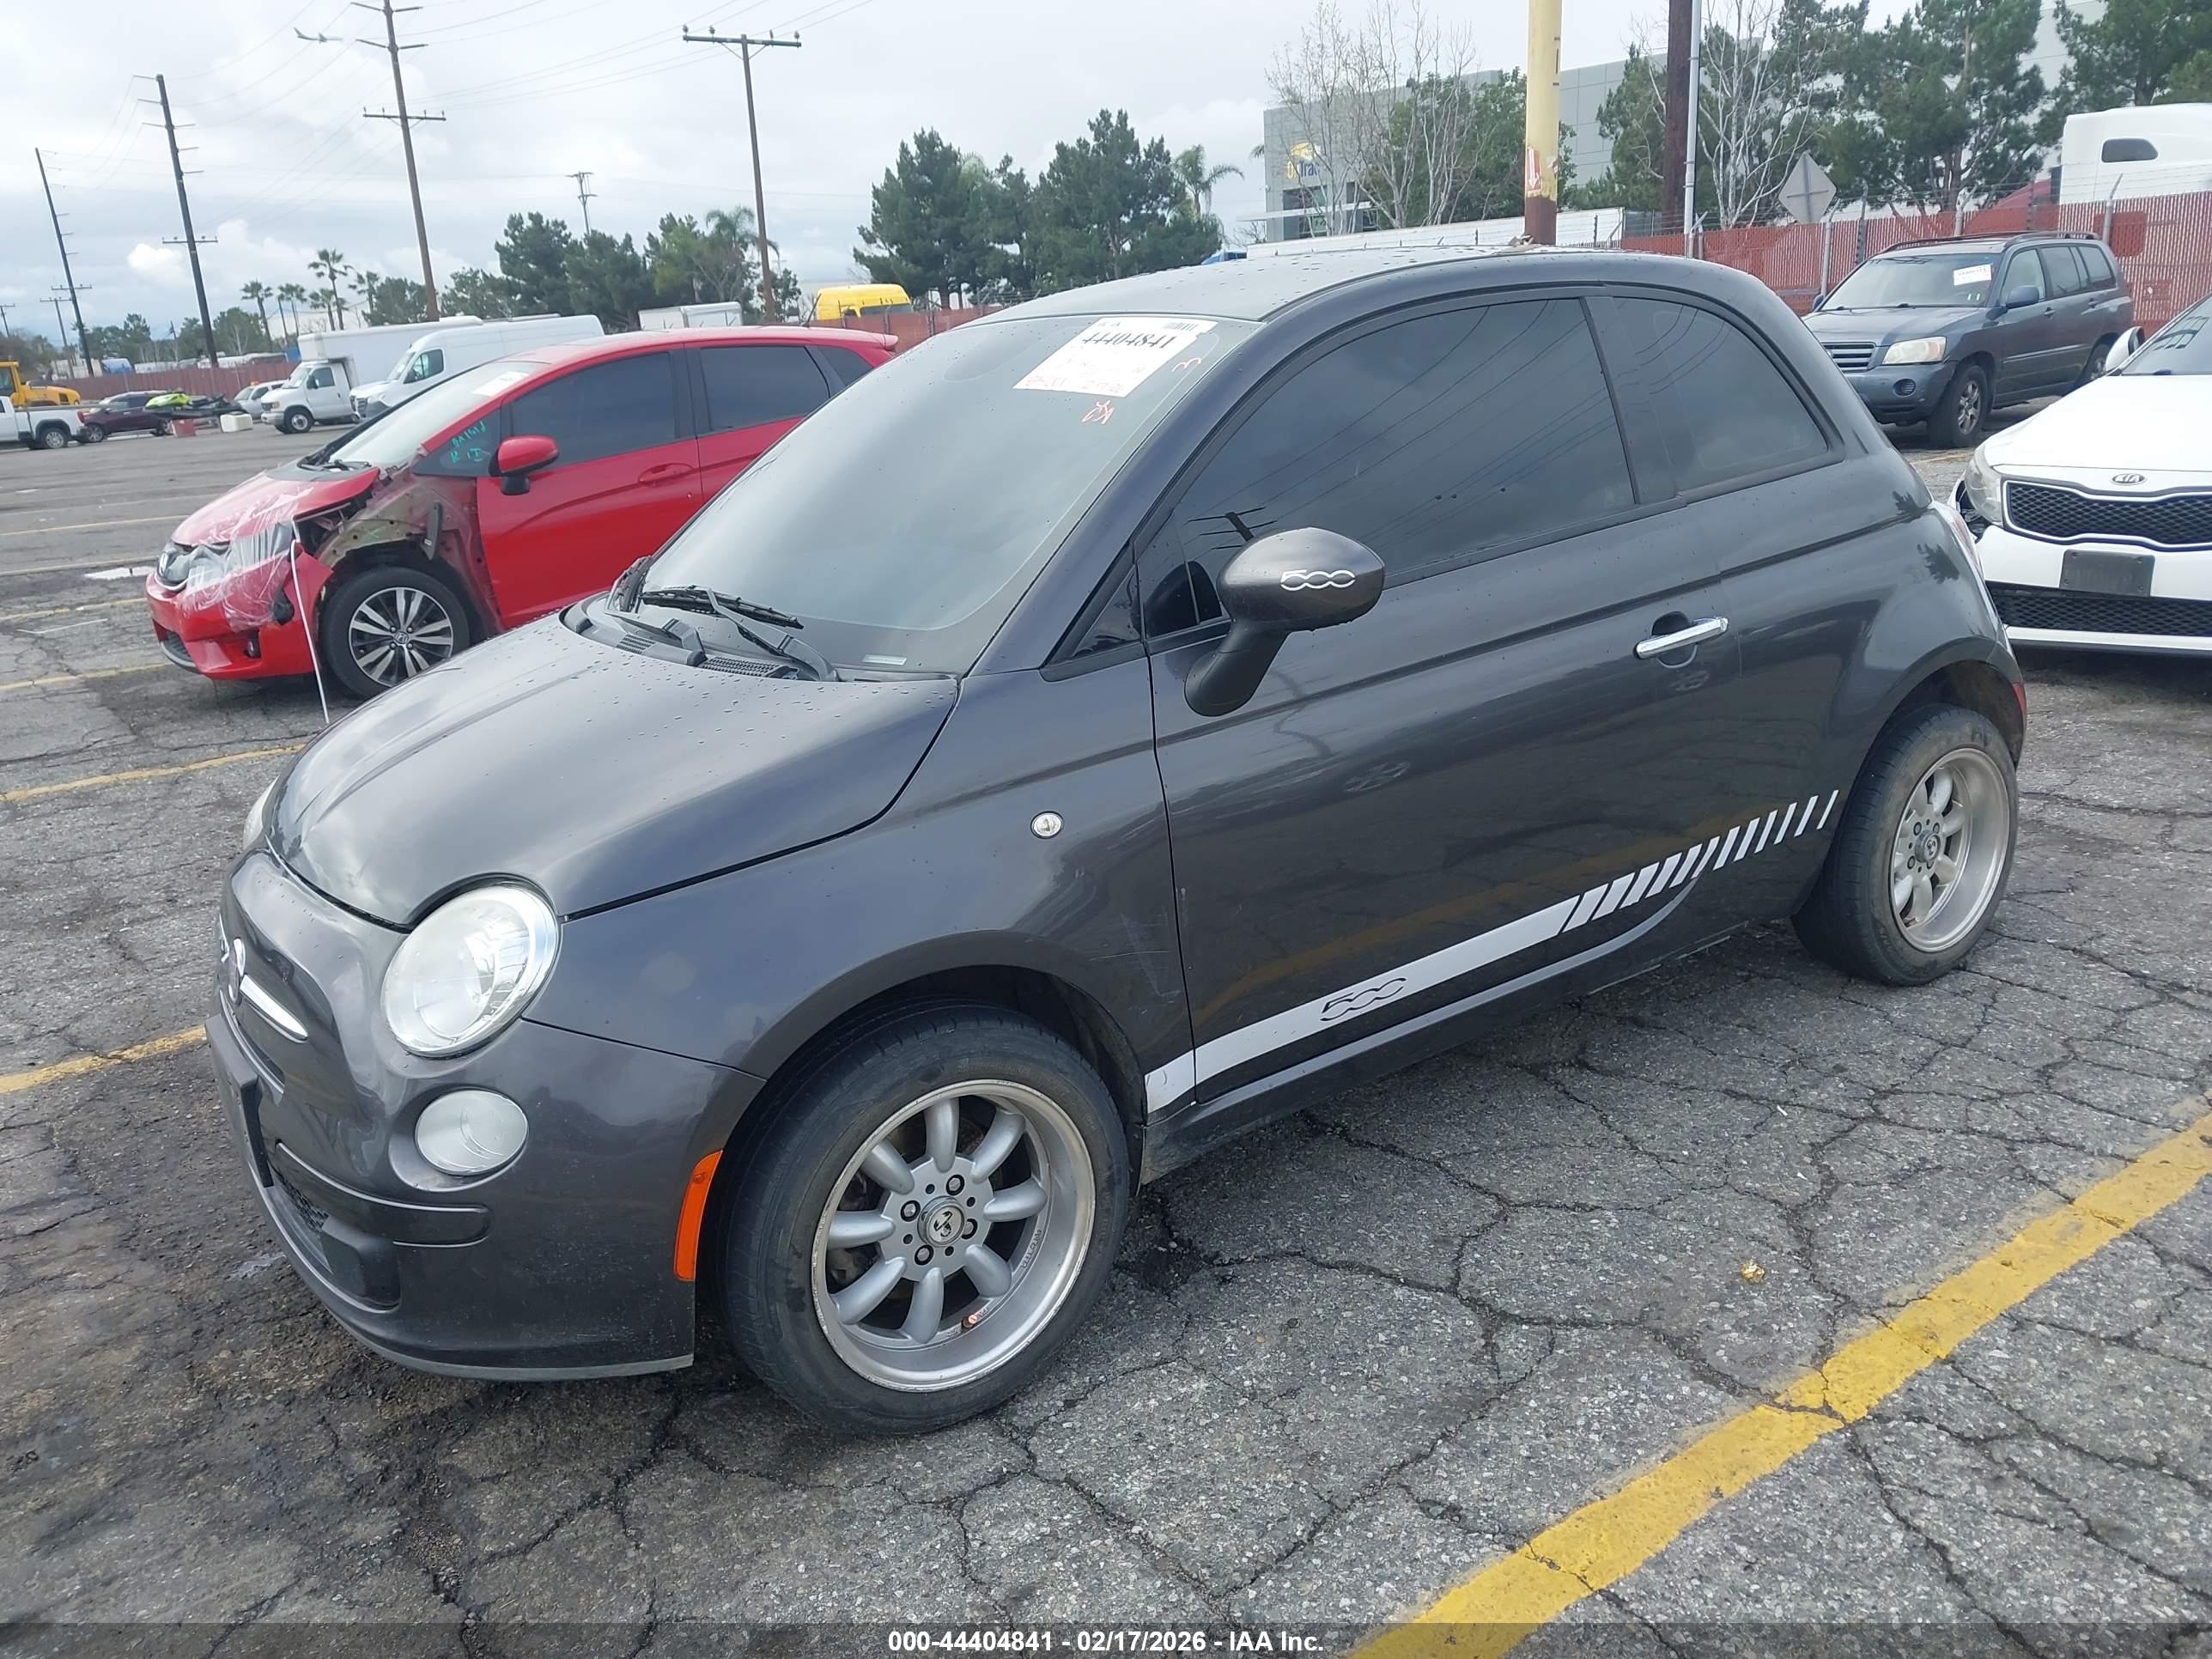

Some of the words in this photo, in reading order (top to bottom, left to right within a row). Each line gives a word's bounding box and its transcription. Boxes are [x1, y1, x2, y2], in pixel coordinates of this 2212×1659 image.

[1082, 331, 1178, 349] 44404841
[1280, 568, 1357, 592] 500
[1319, 977, 1407, 1022] 500
